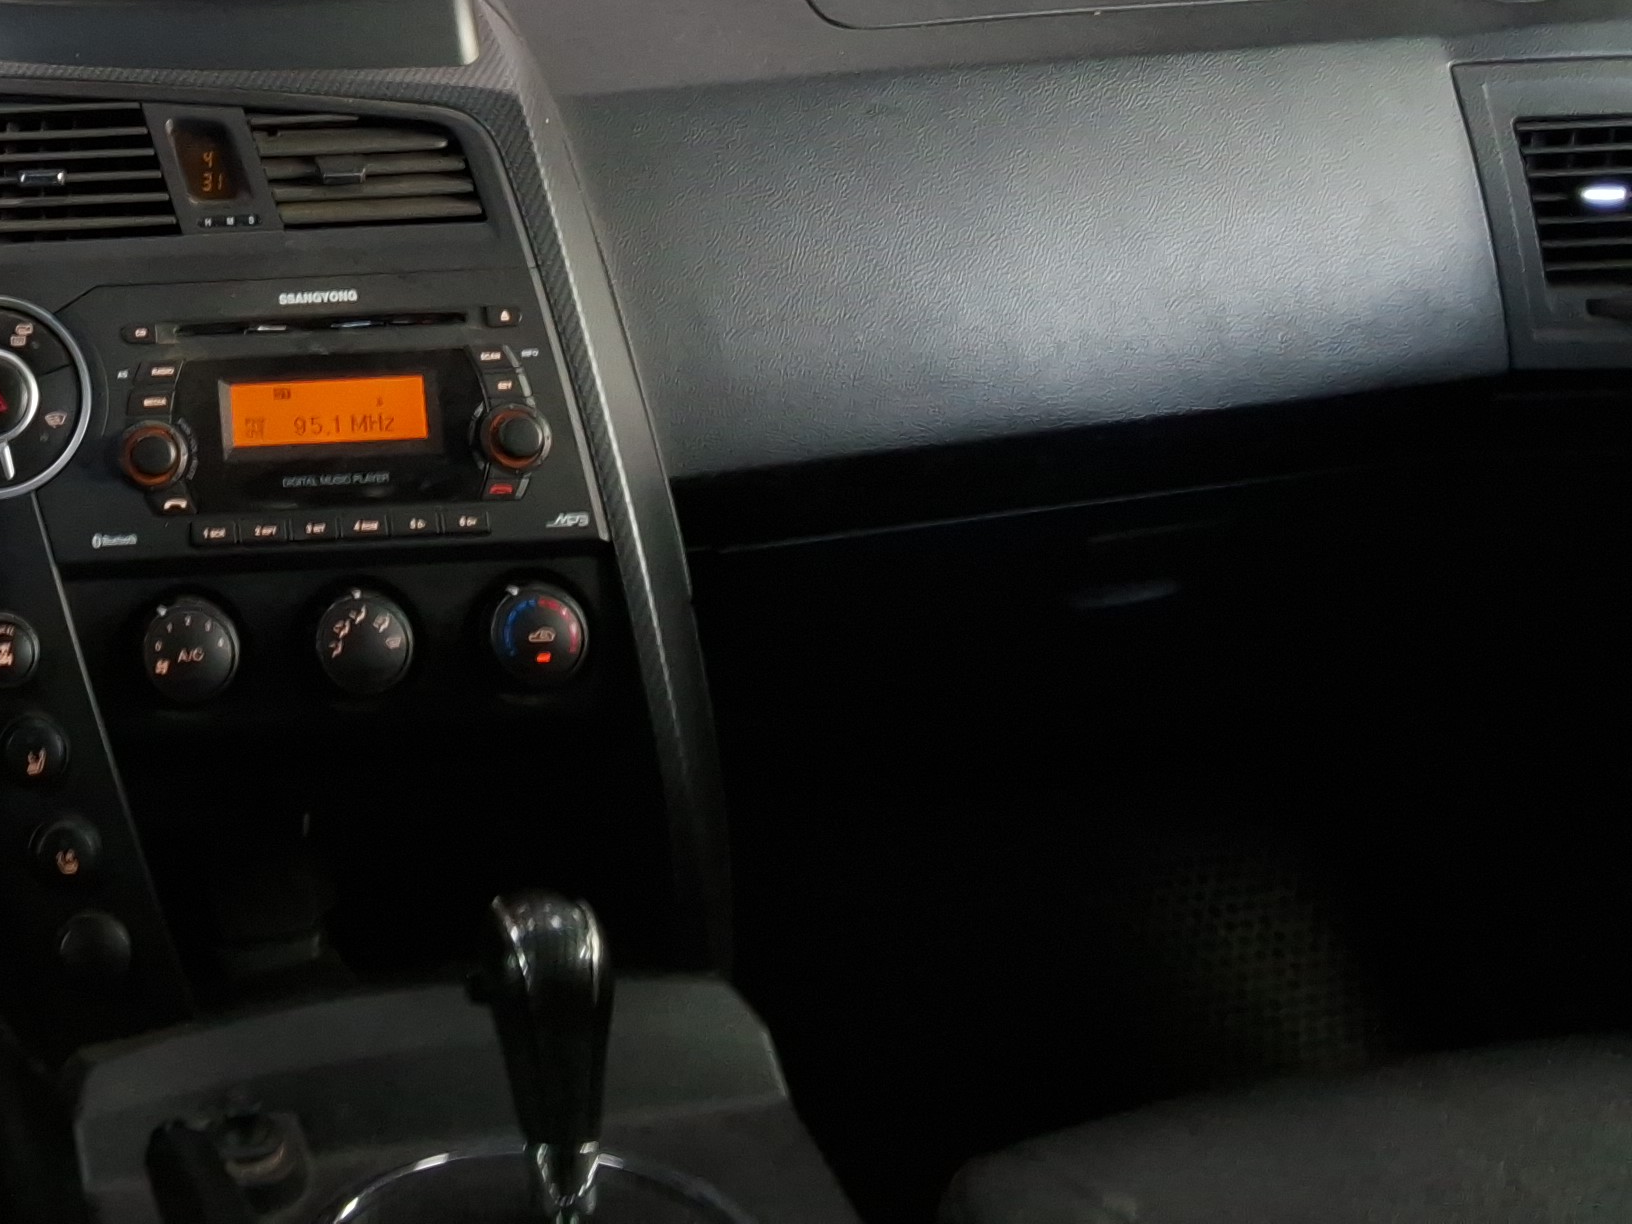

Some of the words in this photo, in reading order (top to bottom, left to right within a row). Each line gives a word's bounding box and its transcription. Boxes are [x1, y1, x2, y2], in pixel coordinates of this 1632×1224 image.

[278, 289, 358, 305] SSANGYONG
[293, 414, 341, 437] 95.1
[350, 413, 395, 434] MHz
[282, 474, 317, 488] DIGITAL
[319, 473, 350, 486] MUSIC
[353, 472, 390, 484] PLAYER
[177, 647, 205, 664] A/C
